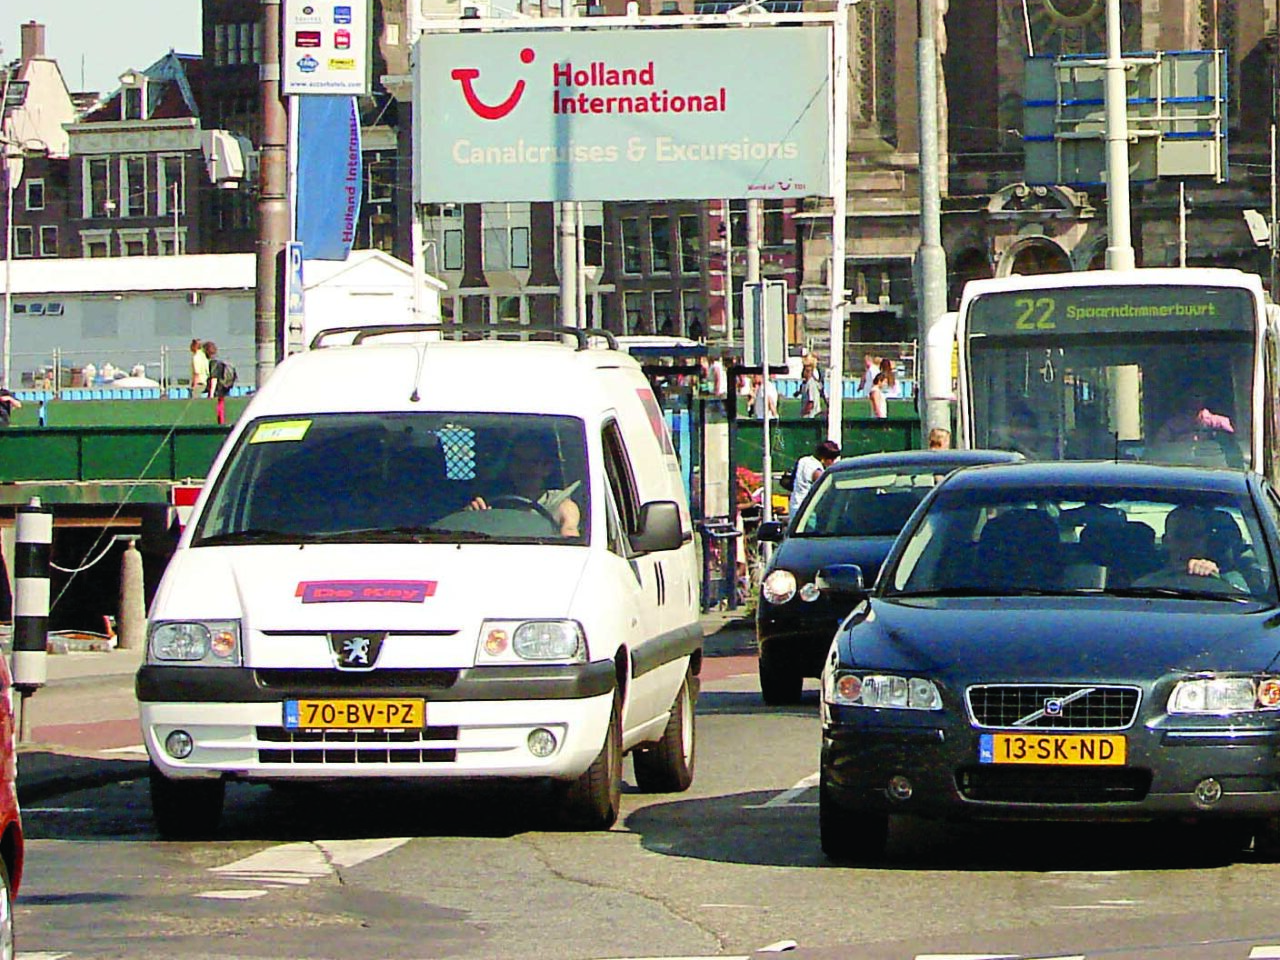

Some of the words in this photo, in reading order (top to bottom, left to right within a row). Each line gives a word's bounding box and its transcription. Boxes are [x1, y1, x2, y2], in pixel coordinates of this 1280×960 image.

[553, 61, 654, 87] Holland
[553, 88, 726, 114] International
[451, 139, 618, 165] Canalcruises
[627, 137, 647, 162] &
[656, 136, 799, 161] Excursions
[1015, 297, 1057, 330] 22
[1066, 302, 1216, 321] Spaarndammerbuurt
[306, 703, 414, 724] 70-BV-PZ
[1003, 737, 1114, 760] 13-SK-ND
